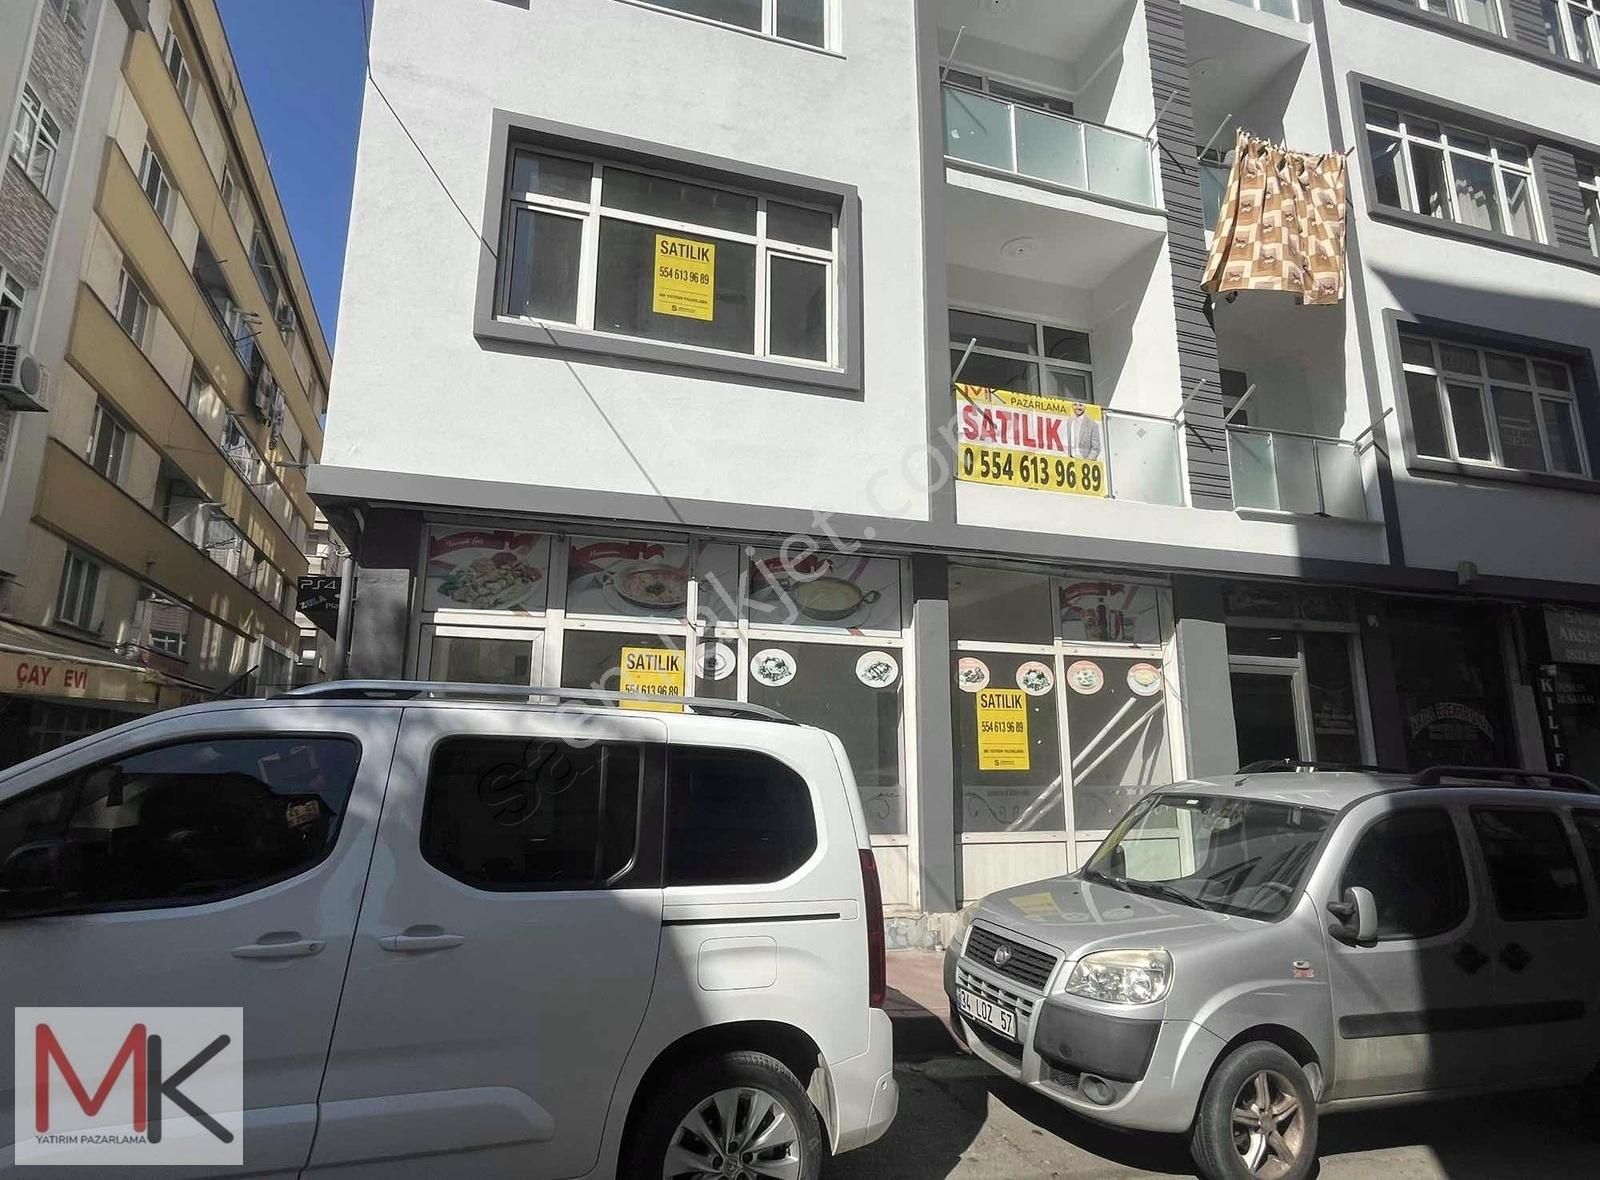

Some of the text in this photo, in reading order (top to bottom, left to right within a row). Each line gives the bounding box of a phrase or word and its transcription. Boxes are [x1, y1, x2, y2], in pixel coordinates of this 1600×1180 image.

[660, 240, 710, 262] SATILIK
[659, 266, 710, 285] 554 613 96 89
[1010, 397, 1067, 415] PAZARLAMA
[962, 404, 1066, 453] SATILIK
[963, 447, 1102, 492] 0 554 613 96 89
[301, 579, 336, 590] PS4
[626, 652, 680, 672] SATILIK
[16, 662, 88, 690] ÇAY EVİ
[641, 684, 656, 695] 613
[980, 693, 1023, 709] SATILIK
[981, 720, 1024, 733] 554 613 96 89
[961, 990, 1012, 1033] 34 LOZ 57
